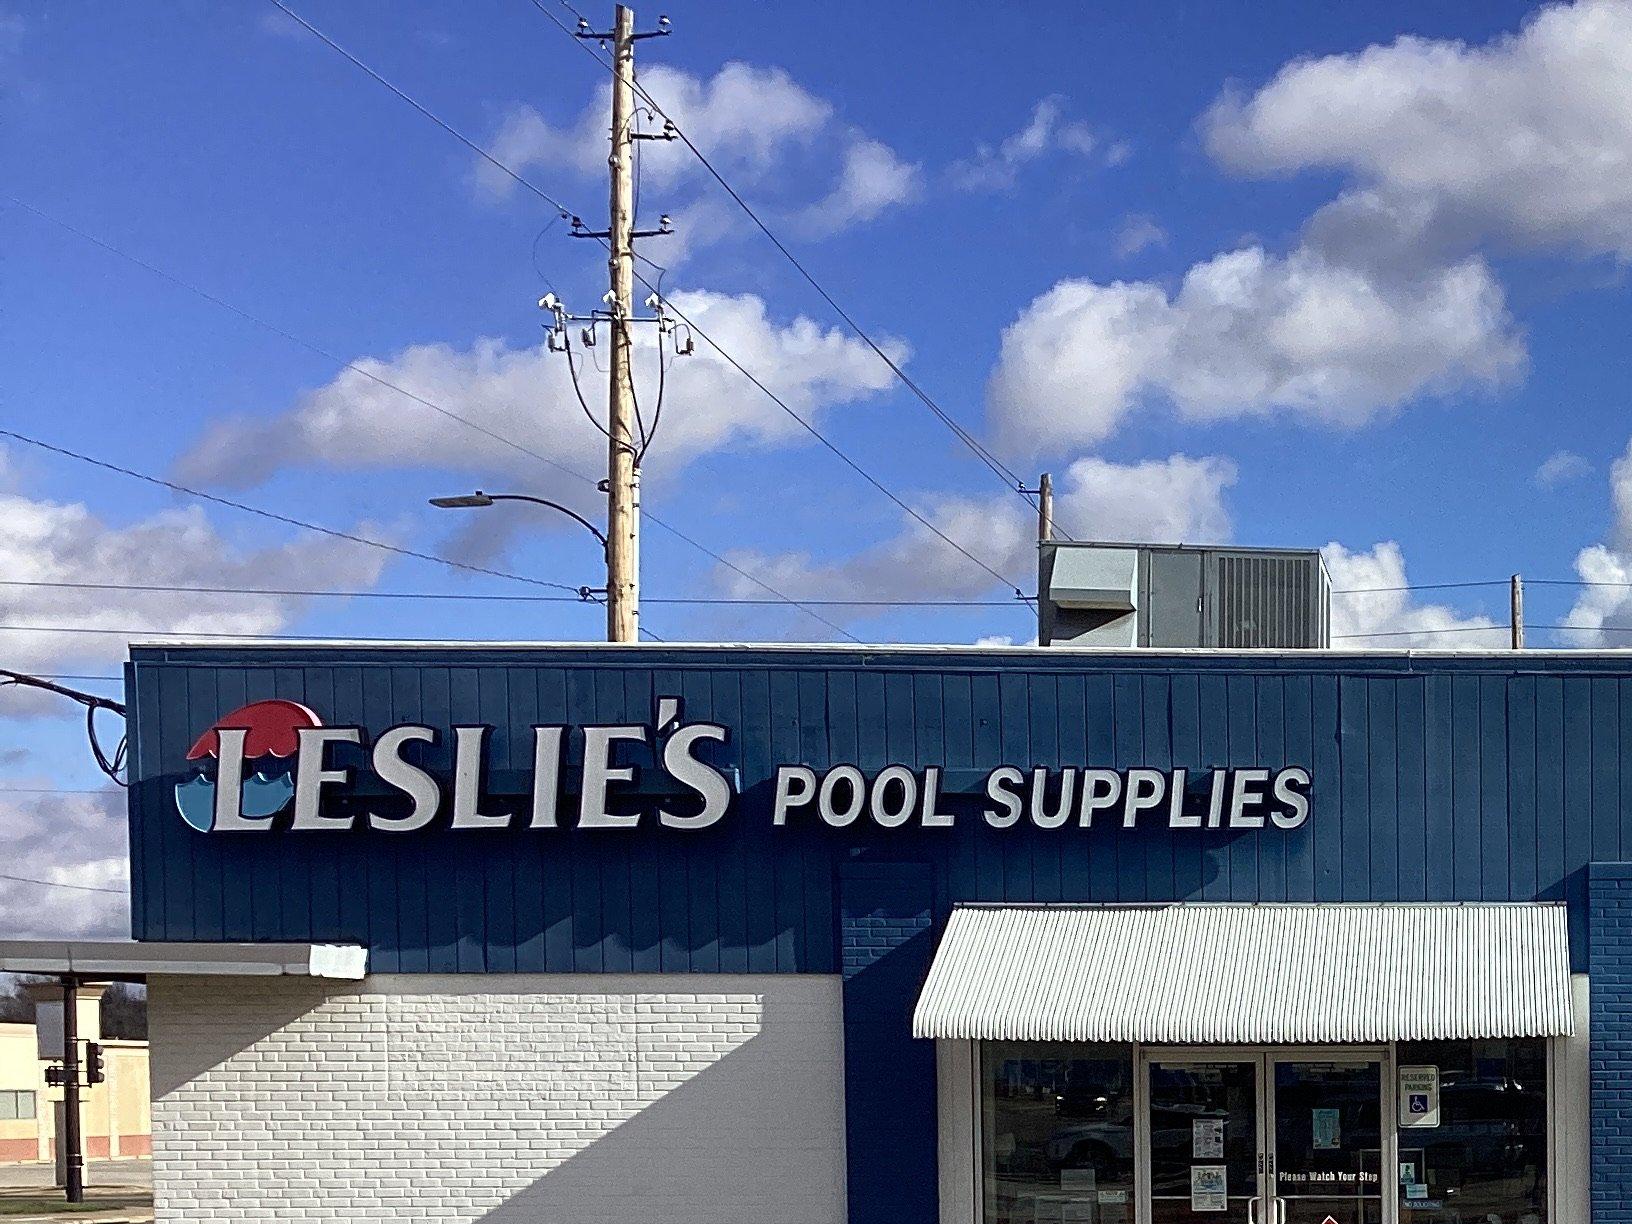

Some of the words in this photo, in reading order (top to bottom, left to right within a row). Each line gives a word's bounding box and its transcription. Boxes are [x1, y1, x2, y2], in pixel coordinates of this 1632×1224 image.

[211, 698, 733, 832] LESLIE'S
[772, 765, 955, 828] POOL
[982, 766, 1312, 829] SUPPLIES
[1401, 1073, 1436, 1082] RESERVED
[1404, 1083, 1433, 1092] PARKING
[1279, 1171, 1307, 1182] Please
[1308, 1171, 1336, 1182] Watch
[1337, 1171, 1357, 1182] Your
[1358, 1171, 1378, 1182] Step
